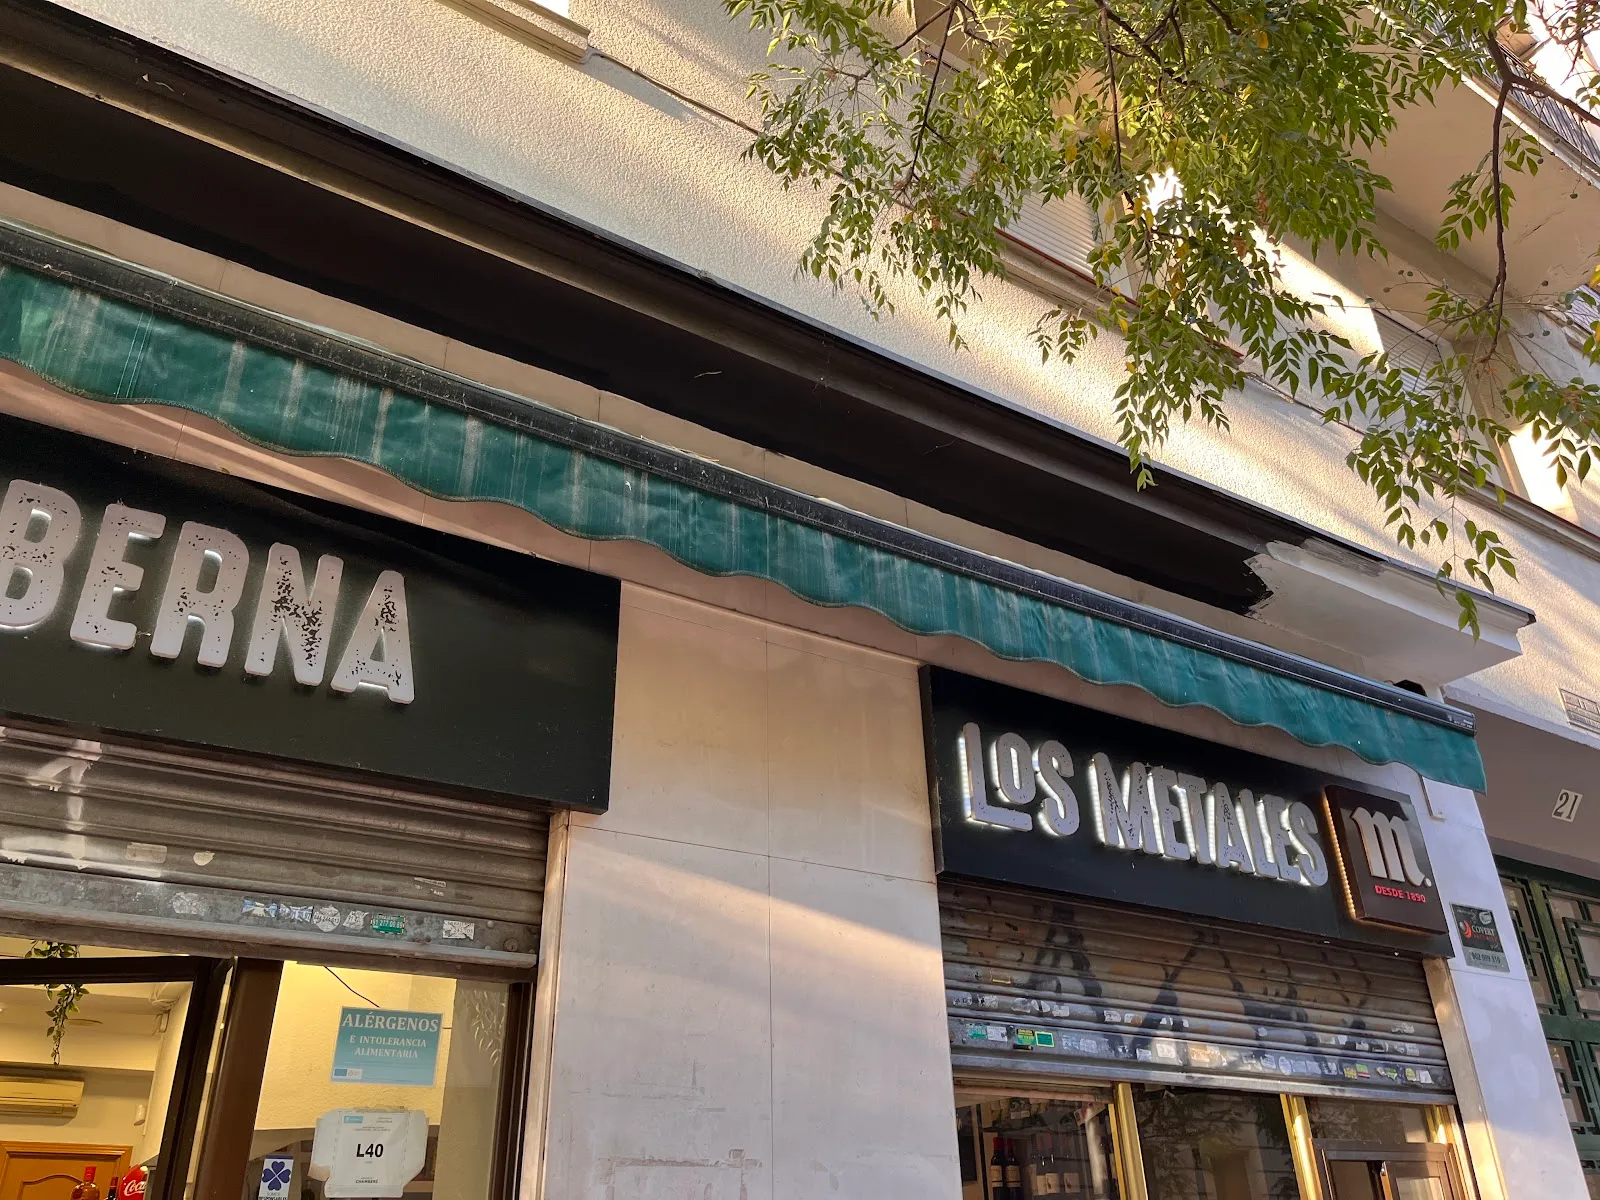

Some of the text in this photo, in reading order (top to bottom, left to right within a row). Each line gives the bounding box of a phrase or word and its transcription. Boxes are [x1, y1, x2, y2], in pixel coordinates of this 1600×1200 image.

[0, 479, 414, 704] BERNA
[960, 722, 1328, 887] LOS METALES
[1553, 791, 1578, 820] 21
[1374, 885, 1427, 903] DESDE 1890
[341, 1011, 439, 1033] ALÉRGENOS
[359, 1035, 427, 1047] INTOLERANCIA
[354, 1047, 419, 1059] ALIMENTARIA
[356, 1143, 384, 1158] L40
